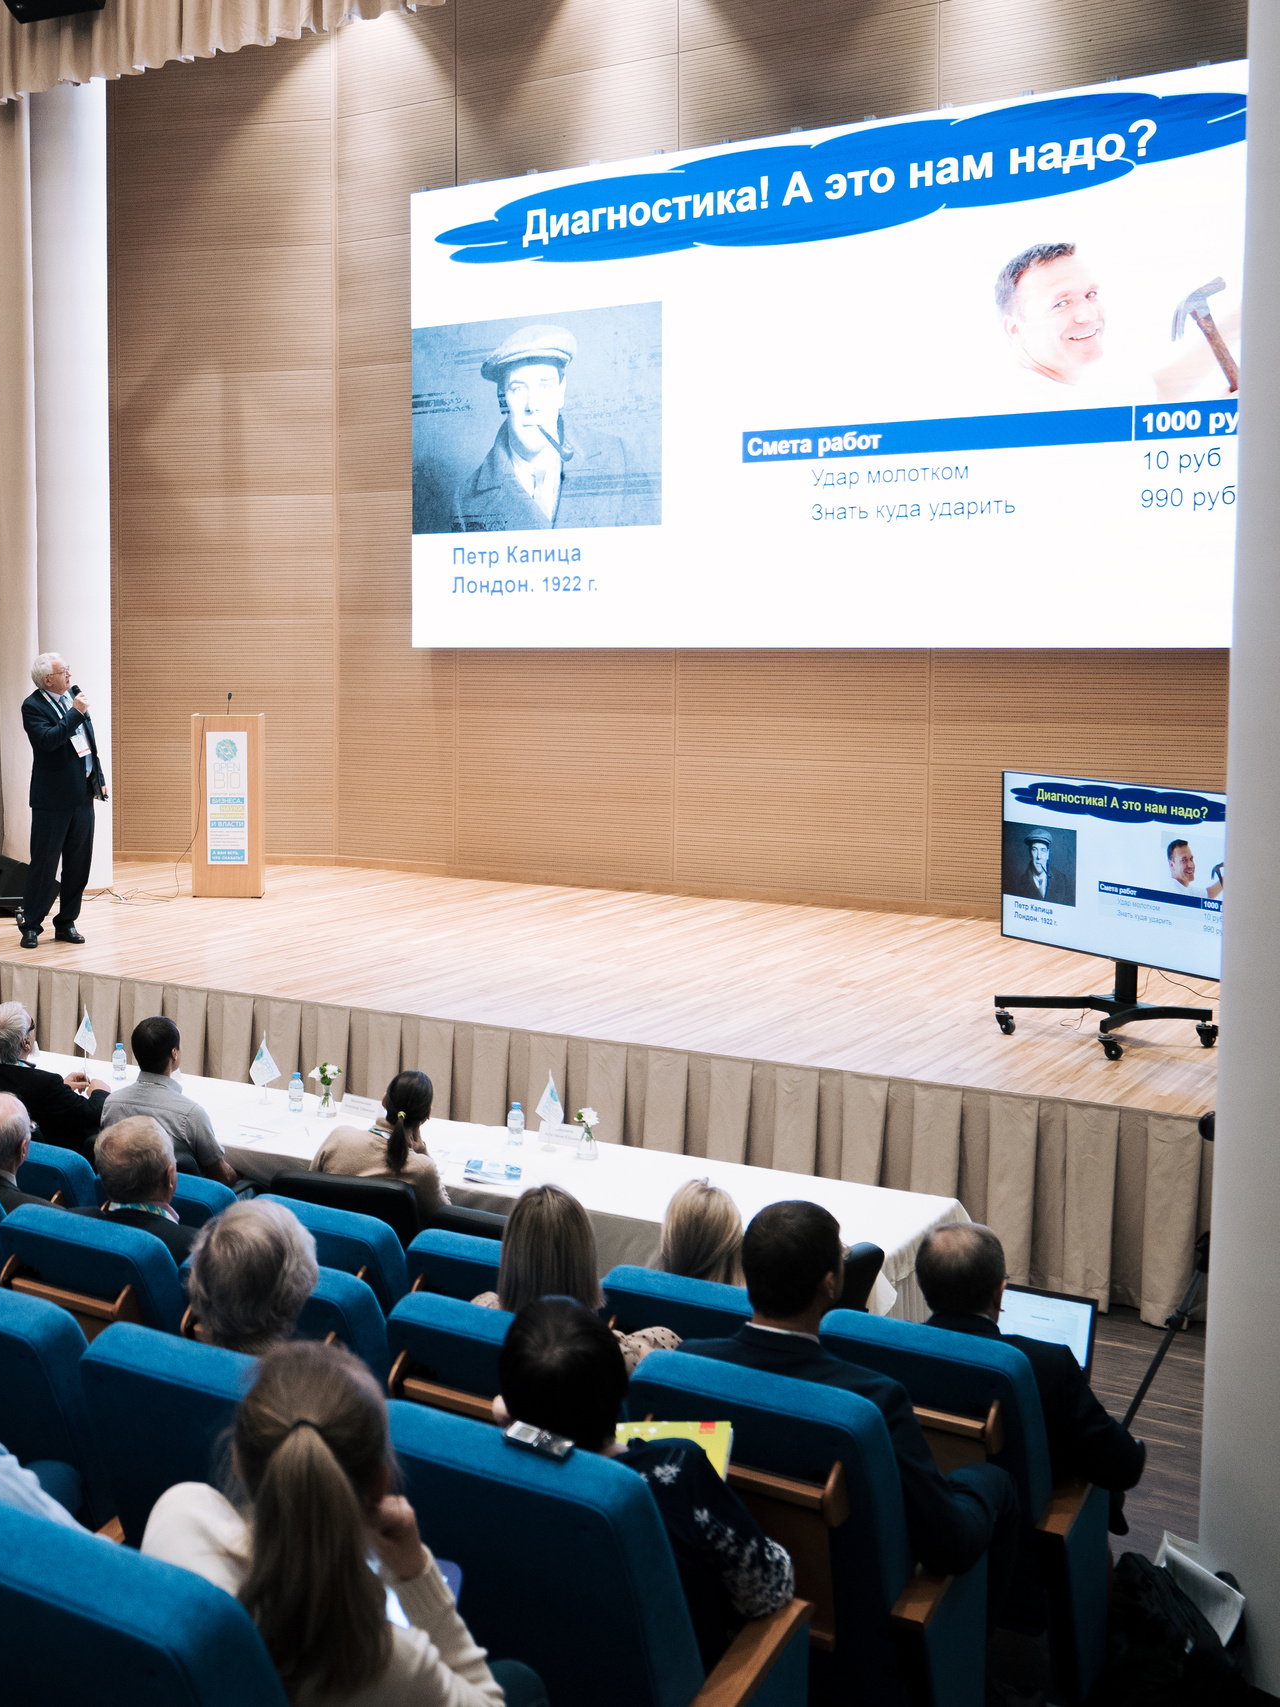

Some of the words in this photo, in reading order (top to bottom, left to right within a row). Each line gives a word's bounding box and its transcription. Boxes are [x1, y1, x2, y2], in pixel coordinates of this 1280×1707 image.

[522, 176, 771, 247] Диагностика!
[781, 170, 814, 207] А
[824, 165, 896, 202] это
[909, 151, 995, 190] нам
[1008, 117, 1159, 176] надо?
[1142, 409, 1202, 433] 1000
[1208, 411, 1239, 435] ру
[747, 437, 812, 456] Смета
[818, 431, 883, 457] работ
[1143, 450, 1169, 470] 10
[1179, 447, 1221, 474] руб
[811, 468, 860, 489] Удар
[867, 465, 969, 484] молотком
[1141, 487, 1183, 508] 990
[1193, 485, 1236, 512] руб
[811, 503, 869, 521] Знать
[876, 503, 921, 523] куда
[929, 499, 1016, 522] ударить
[453, 547, 499, 568] Петр
[507, 545, 581, 565] Капица
[452, 576, 534, 596] Лондон.
[542, 575, 582, 592] 1922
[588, 579, 598, 592] г.
[213, 762, 241, 772] OPEN
[213, 772, 241, 790] BIO
[1036, 788, 1108, 807] Диагностика!
[1110, 796, 1120, 809] А
[1121, 800, 1142, 812] это
[1144, 803, 1168, 815] нам
[1170, 806, 1209, 819] надо?
[1099, 883, 1118, 893] Смета
[1118, 887, 1138, 896] работ
[1014, 900, 1029, 911] Петр
[1030, 904, 1053, 915] Капица
[1203, 901, 1219, 910] 1000
[1040, 917, 1053, 925] 1922
